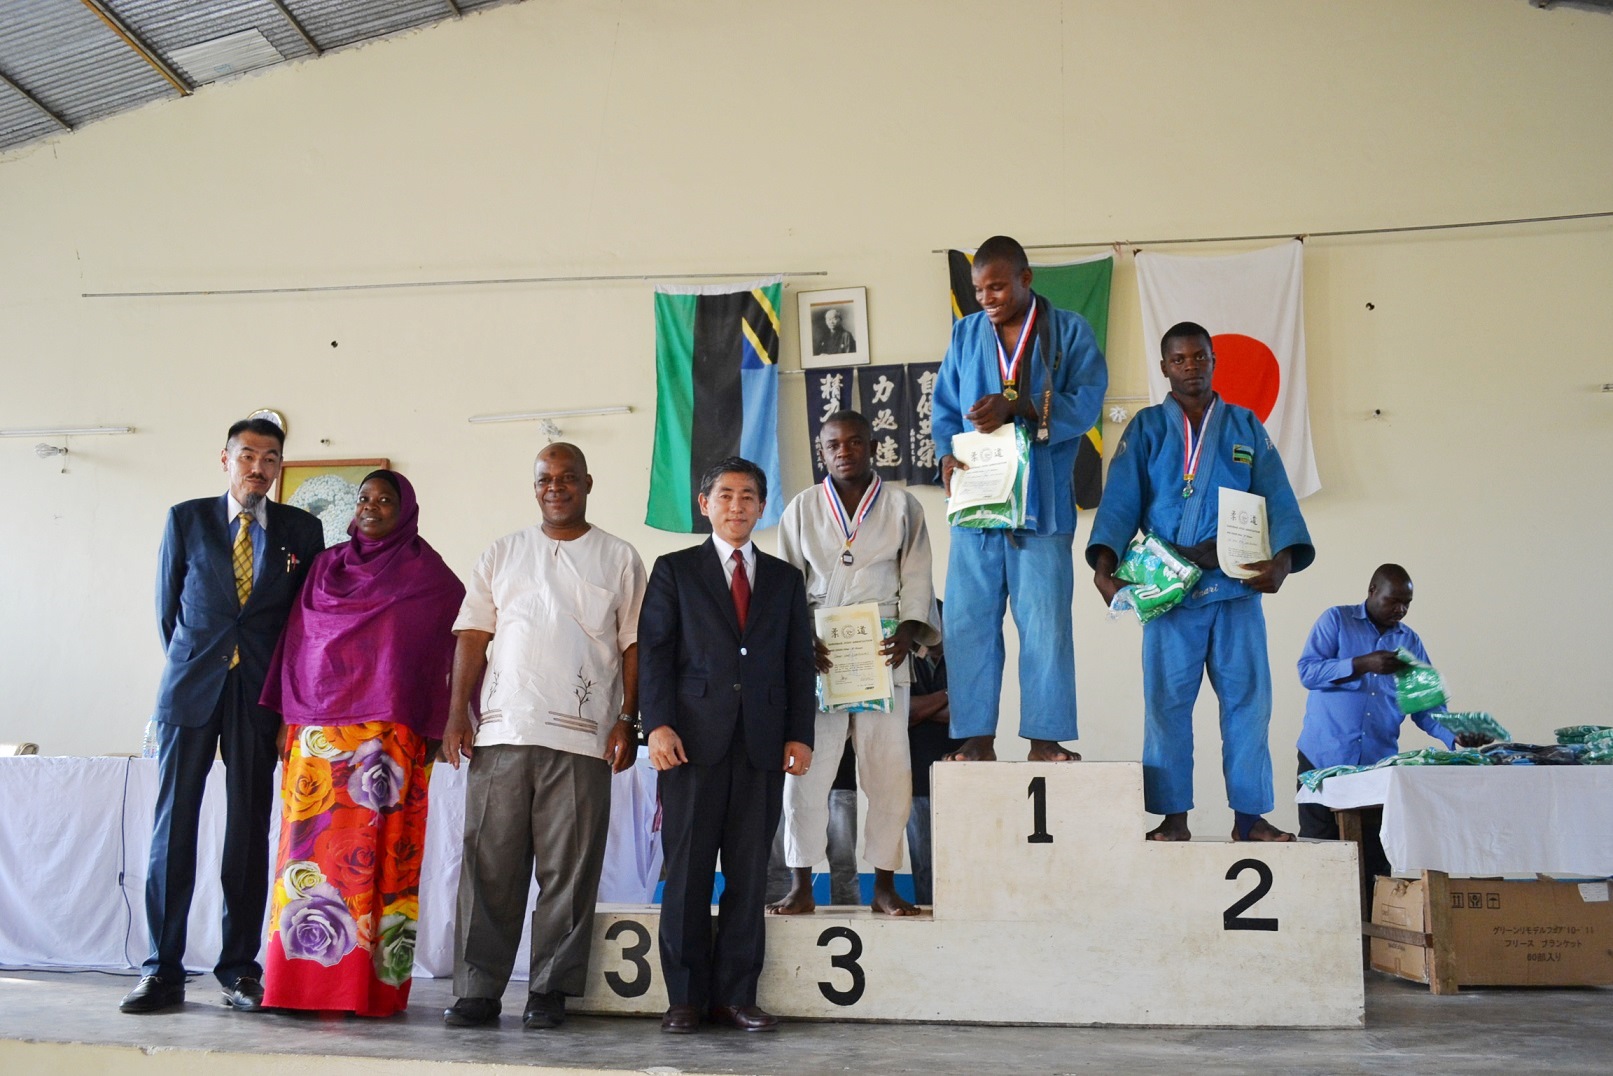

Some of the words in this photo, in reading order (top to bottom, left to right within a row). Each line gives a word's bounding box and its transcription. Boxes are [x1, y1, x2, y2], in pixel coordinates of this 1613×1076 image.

[1027, 776, 1053, 843] 1
[1223, 858, 1279, 931] 2
[604, 920, 652, 998] 3
[816, 926, 865, 1006] 3
